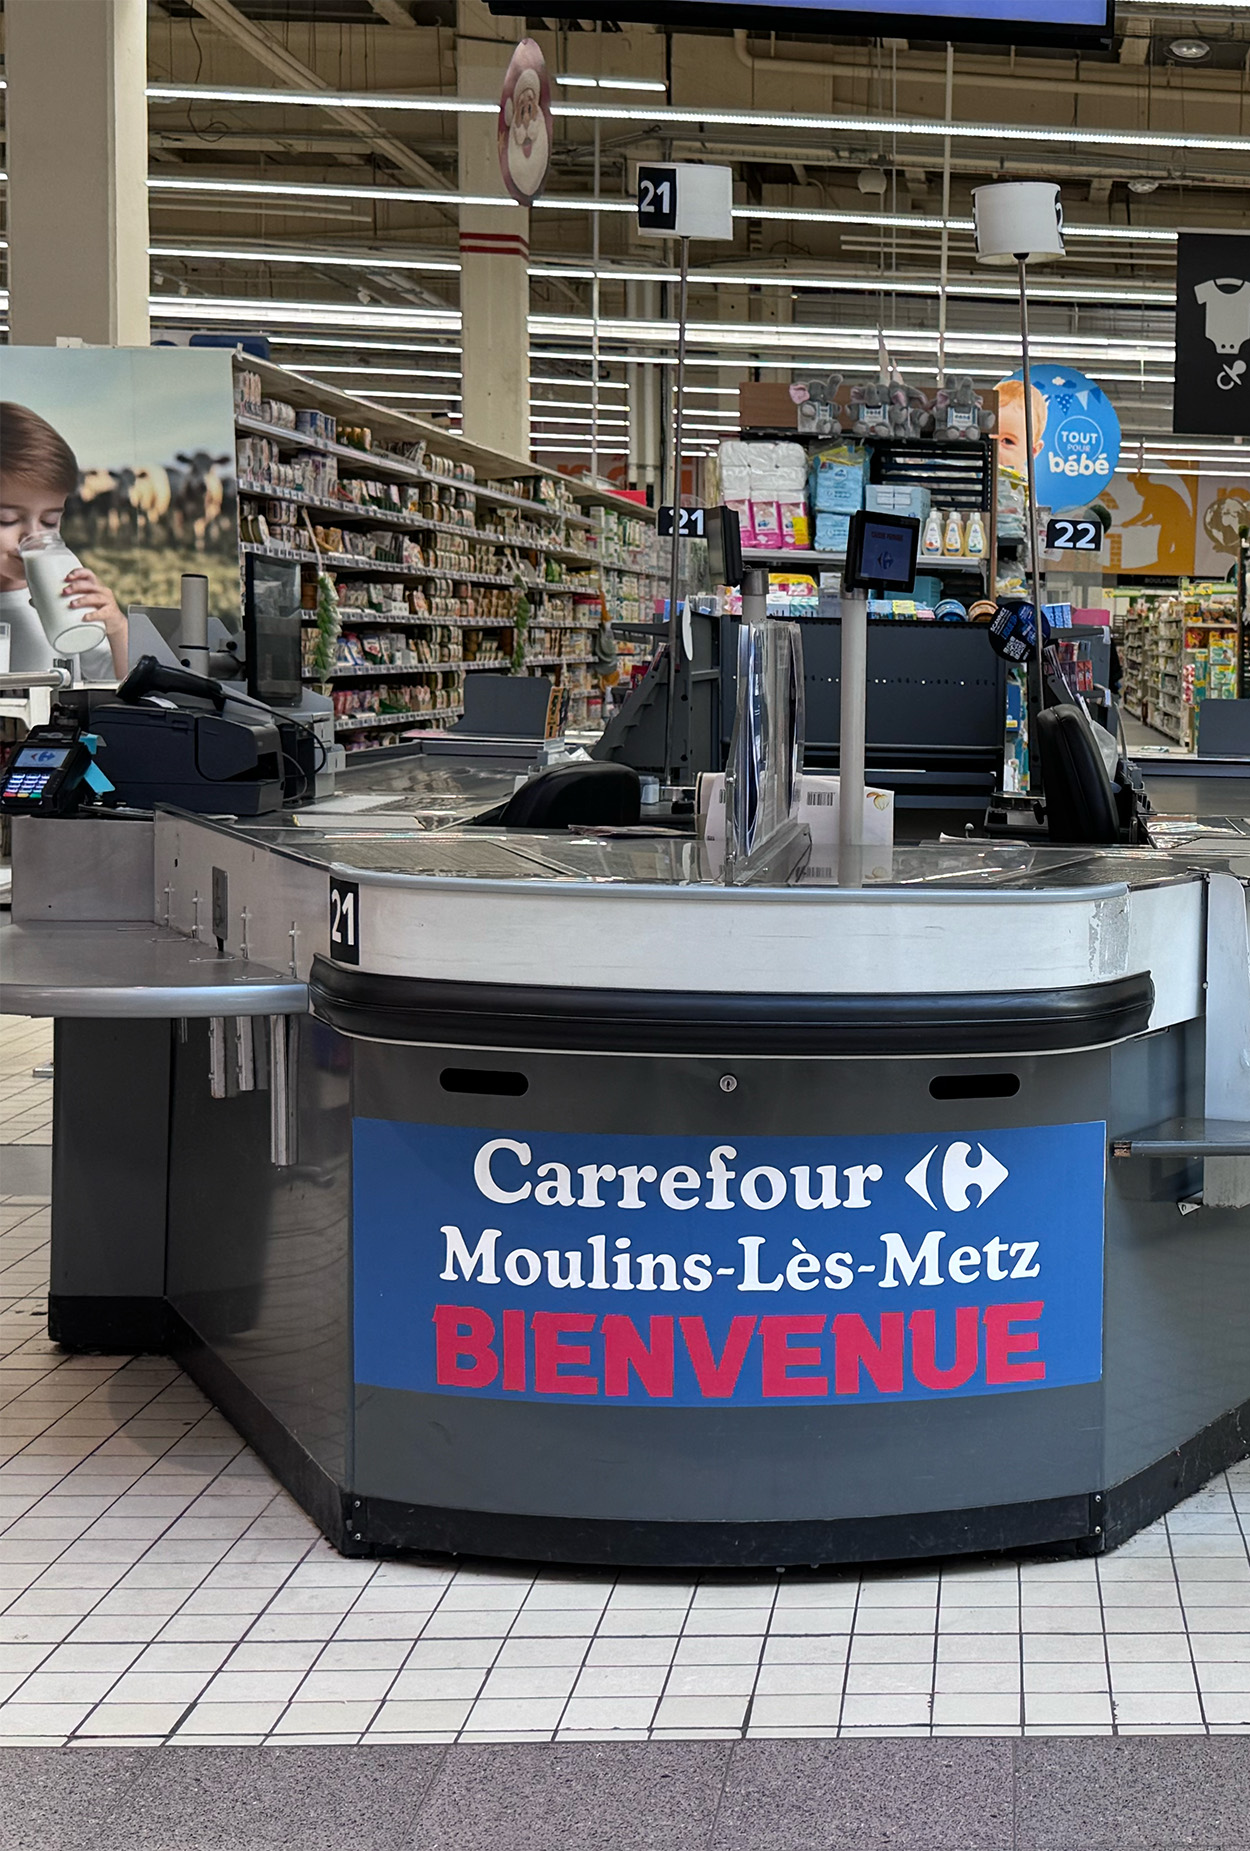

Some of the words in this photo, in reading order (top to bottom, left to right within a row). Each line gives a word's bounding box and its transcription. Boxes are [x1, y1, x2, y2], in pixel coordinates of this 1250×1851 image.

[640, 180, 671, 213] 21
[1061, 431, 1098, 444] TOUT
[1067, 444, 1091, 452] POUR
[1048, 452, 1110, 477] bébé
[668, 508, 704, 535] 21
[1054, 521, 1096, 549] 22
[331, 889, 355, 946] 21
[473, 1138, 883, 1211] Carrefour
[439, 1226, 1042, 1293] Moulins-Lès-Metz
[431, 1301, 1046, 1398] BIENVENUE
